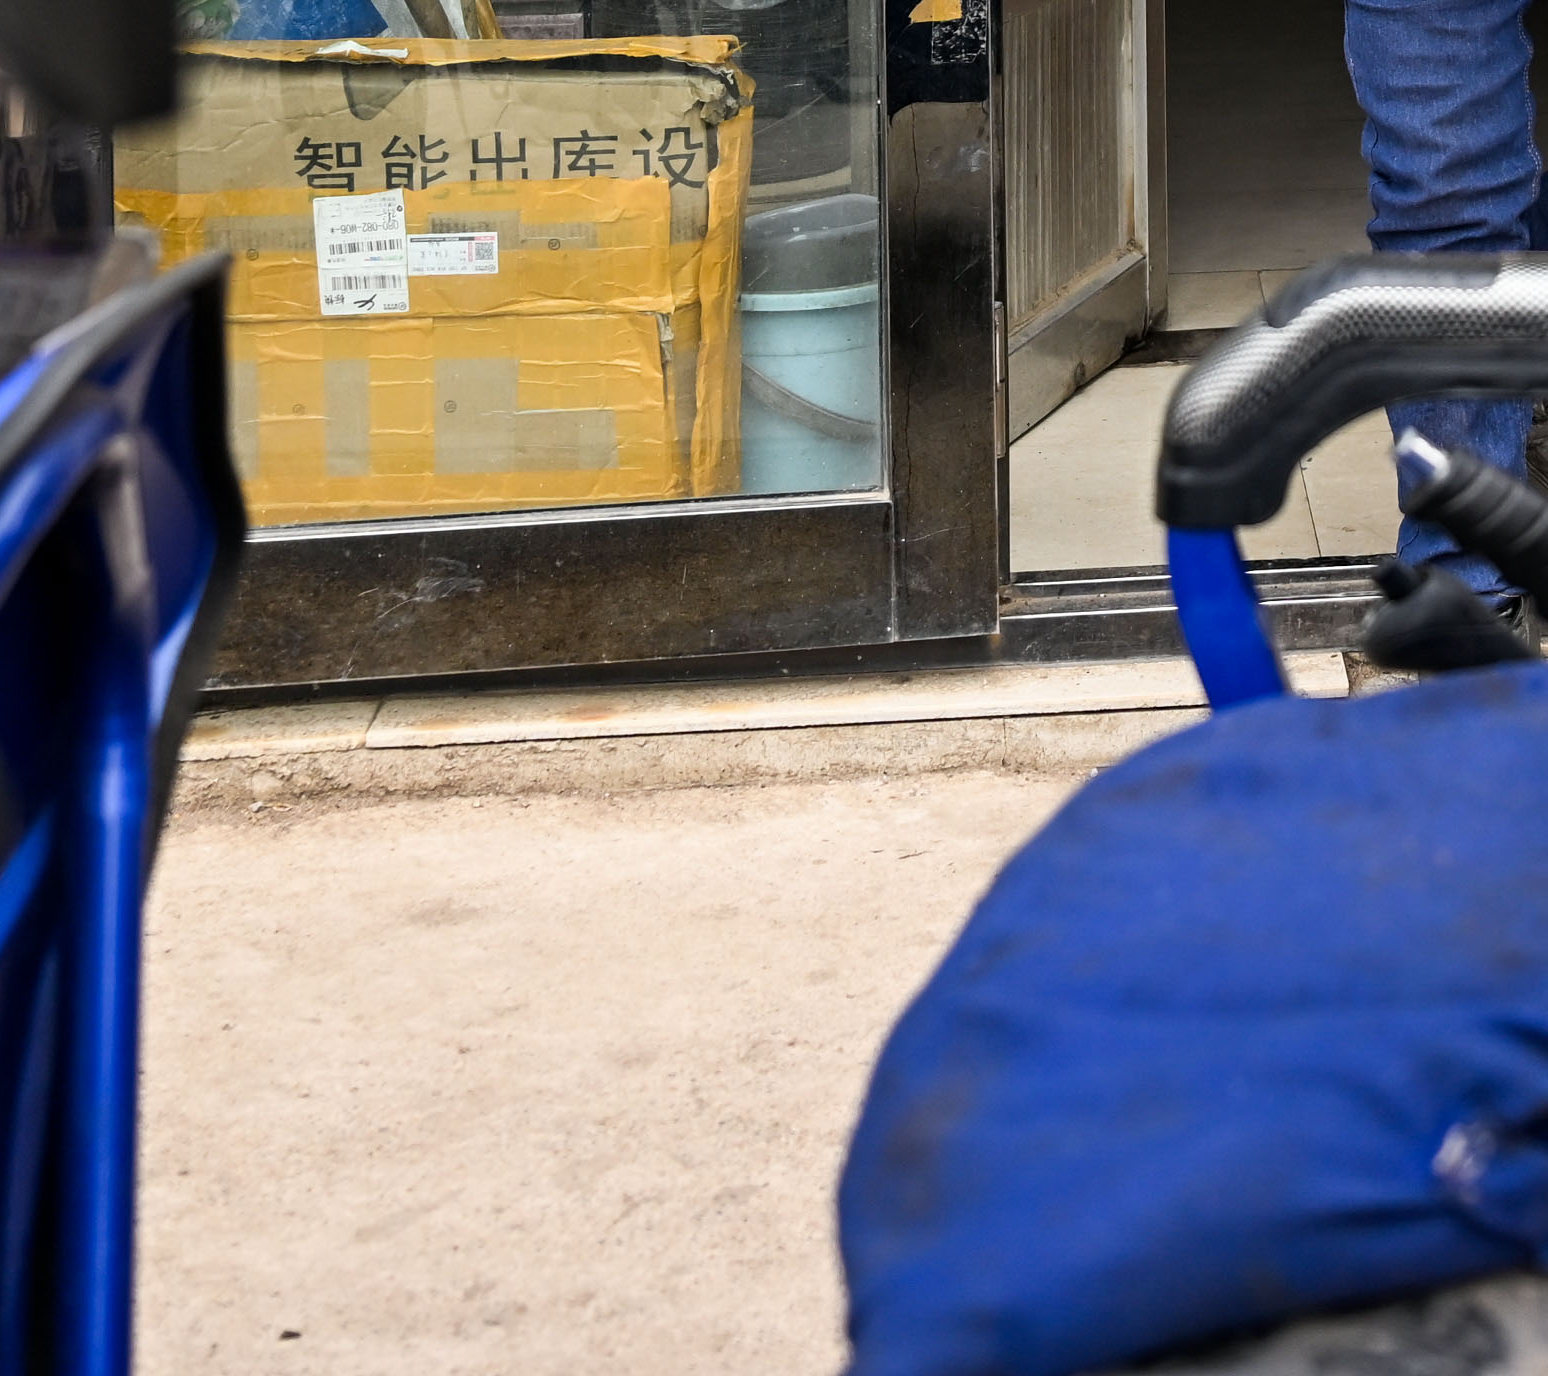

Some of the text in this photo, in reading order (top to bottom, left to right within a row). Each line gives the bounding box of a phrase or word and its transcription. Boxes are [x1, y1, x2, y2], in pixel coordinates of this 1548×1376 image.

[294, 126, 709, 192] 智能出库设
